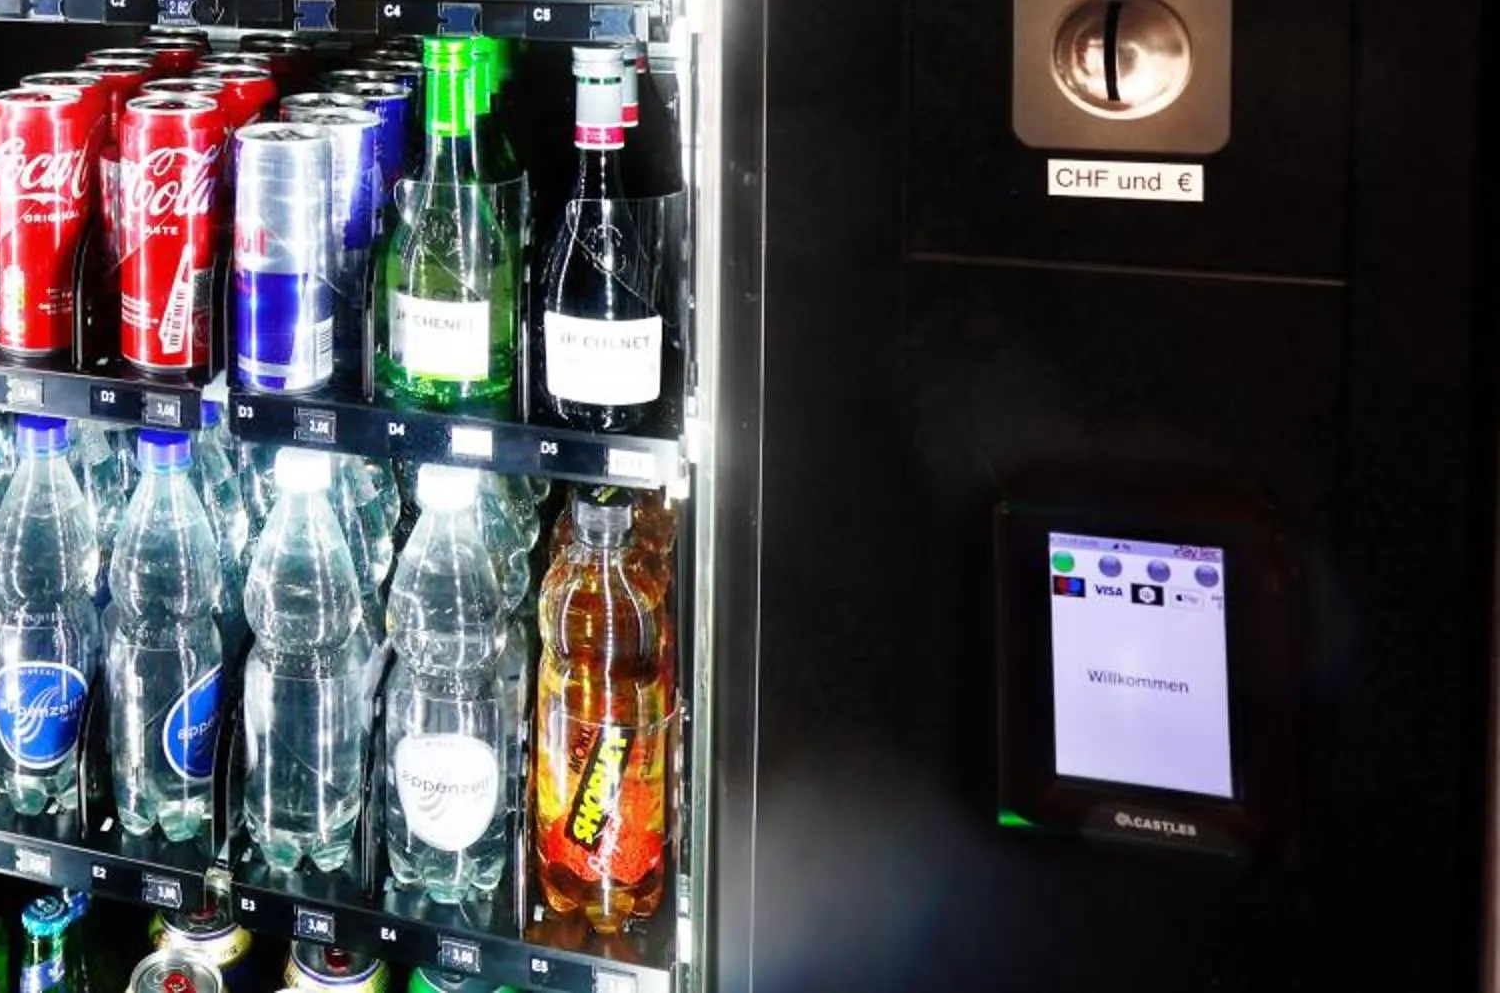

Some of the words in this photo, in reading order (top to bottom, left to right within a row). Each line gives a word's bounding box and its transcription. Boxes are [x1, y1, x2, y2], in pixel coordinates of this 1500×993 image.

[383, 3, 401, 18] C4
[533, 8, 552, 23] C5
[1055, 167, 1109, 188] CHF
[1117, 172, 1162, 192] und
[1177, 172, 1193, 193] €
[135, 225, 179, 236] ASTE
[101, 391, 116, 404] D2
[238, 406, 254, 419] D3
[388, 422, 405, 437] D4
[540, 442, 558, 456] D5
[1094, 584, 1124, 598] VISA
[1087, 668, 1190, 695] Willkommen
[1133, 818, 1197, 836] CASTLES
[92, 865, 107, 880] E2
[241, 898, 256, 912] E3
[380, 928, 397, 942] E4
[531, 959, 548, 974] E5
